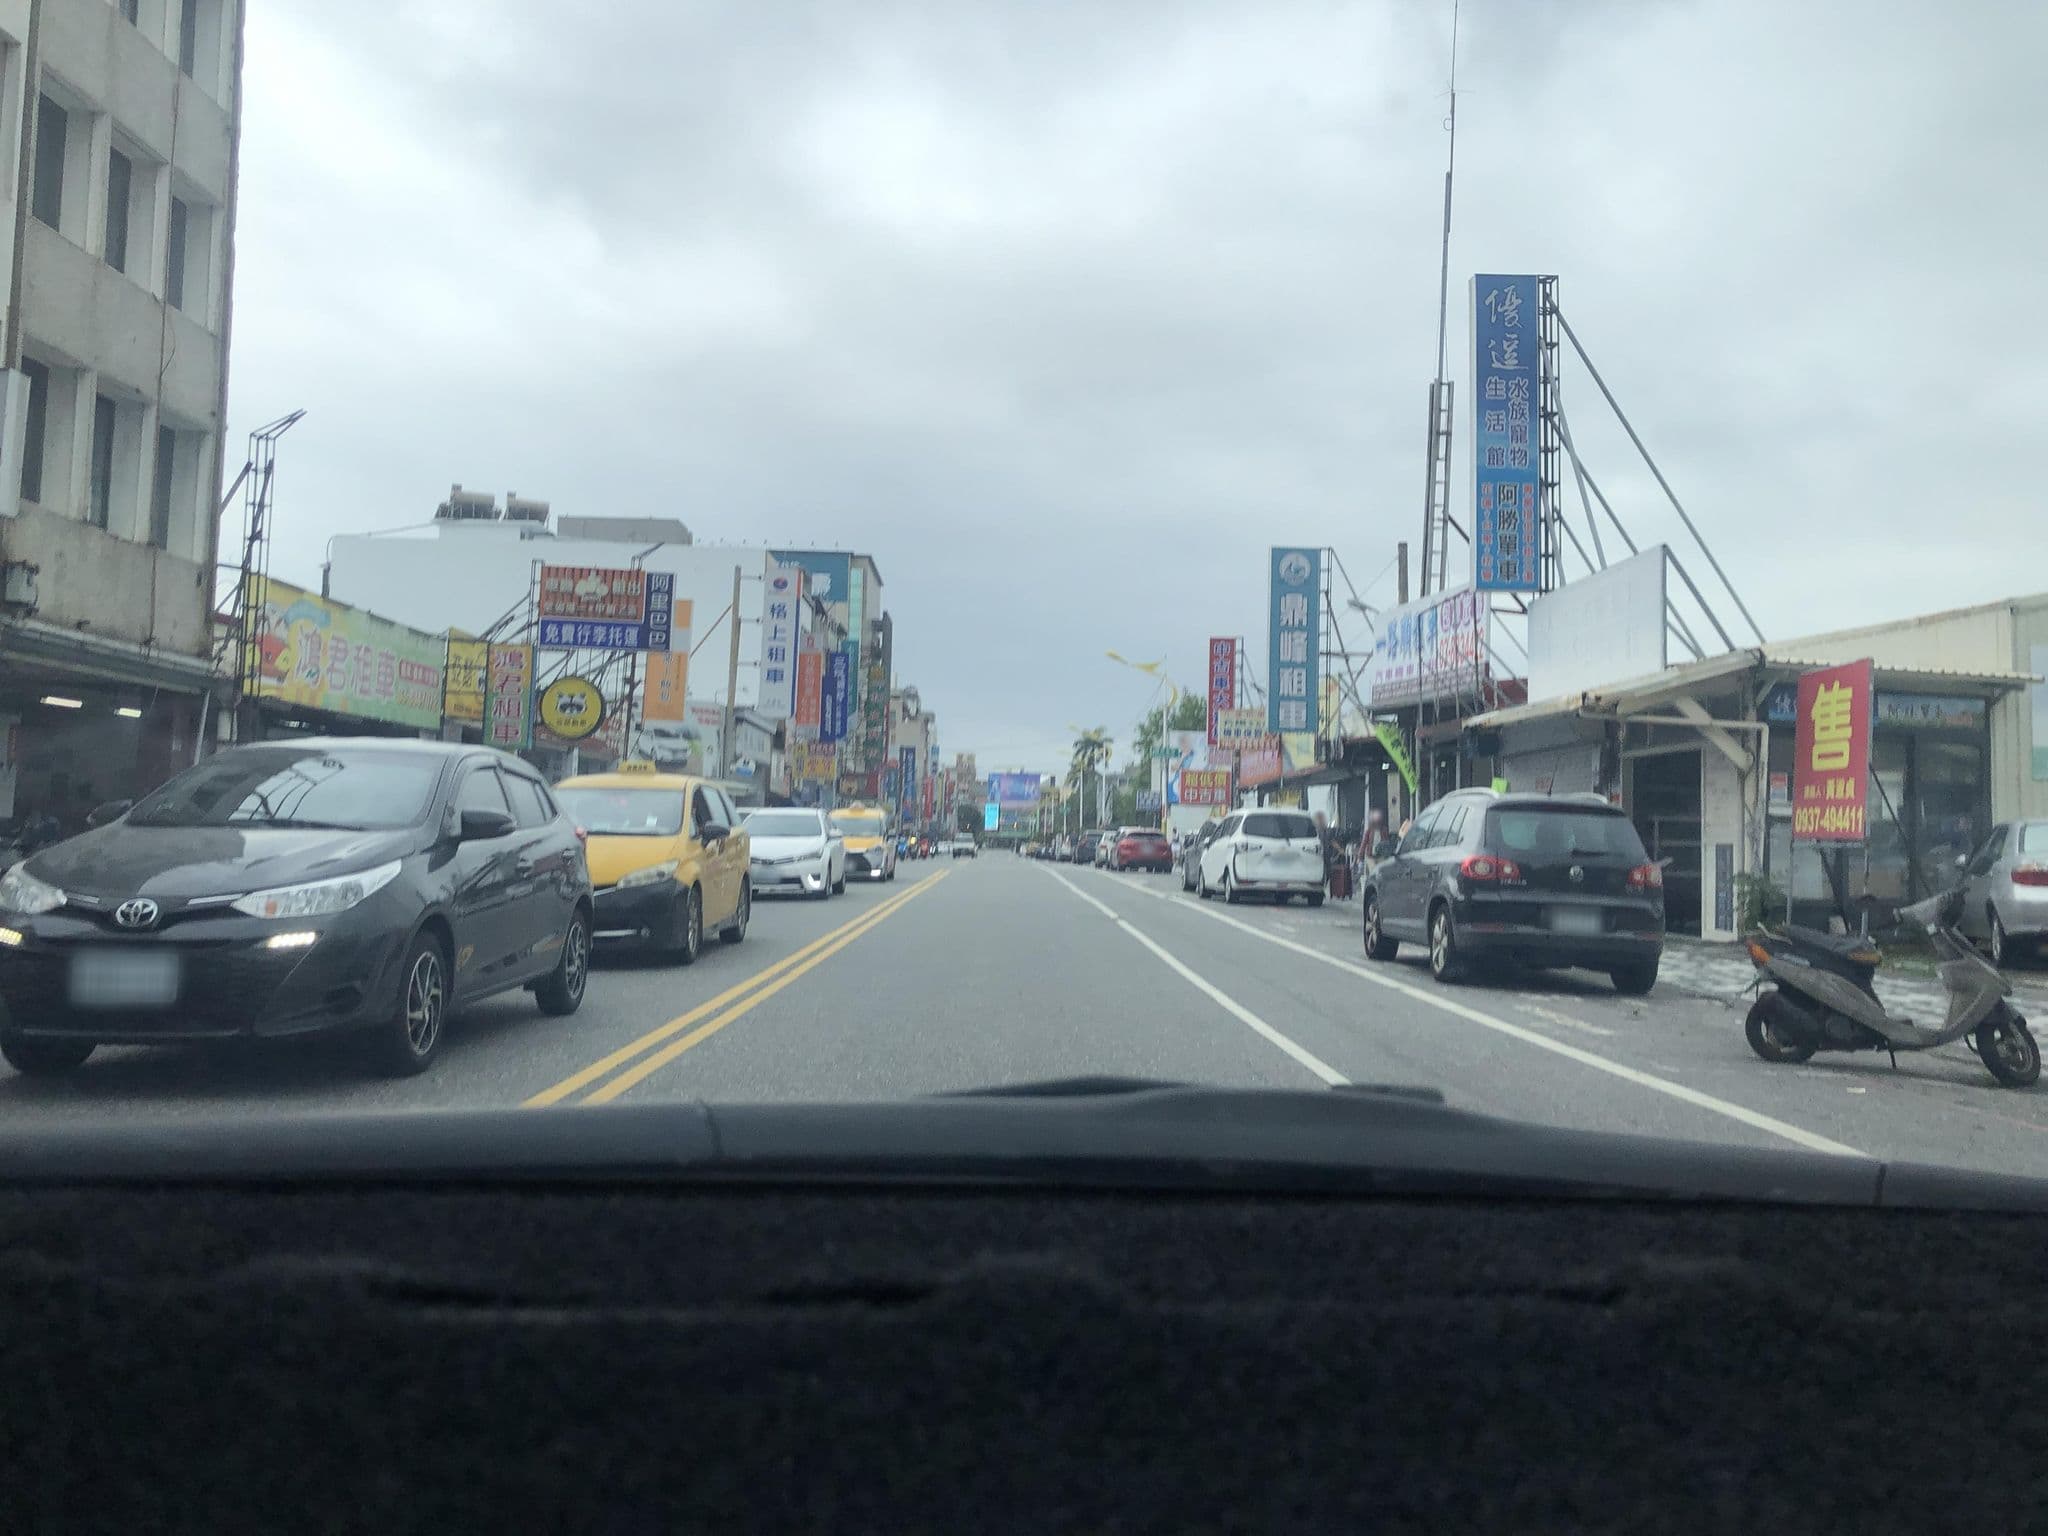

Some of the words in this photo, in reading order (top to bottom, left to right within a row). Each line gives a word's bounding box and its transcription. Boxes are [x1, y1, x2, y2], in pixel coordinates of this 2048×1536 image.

[1485, 376, 1506, 469] 生活館
[1508, 376, 1529, 469] 水族寵物
[1497, 481, 1519, 584] 阿勝單車
[545, 623, 639, 647] 免費行李托運
[649, 574, 669, 647] 阿里巴巴
[766, 603, 787, 683] 格上租車
[1812, 681, 1853, 771] 售
[1795, 804, 1863, 833] 0937-494411
